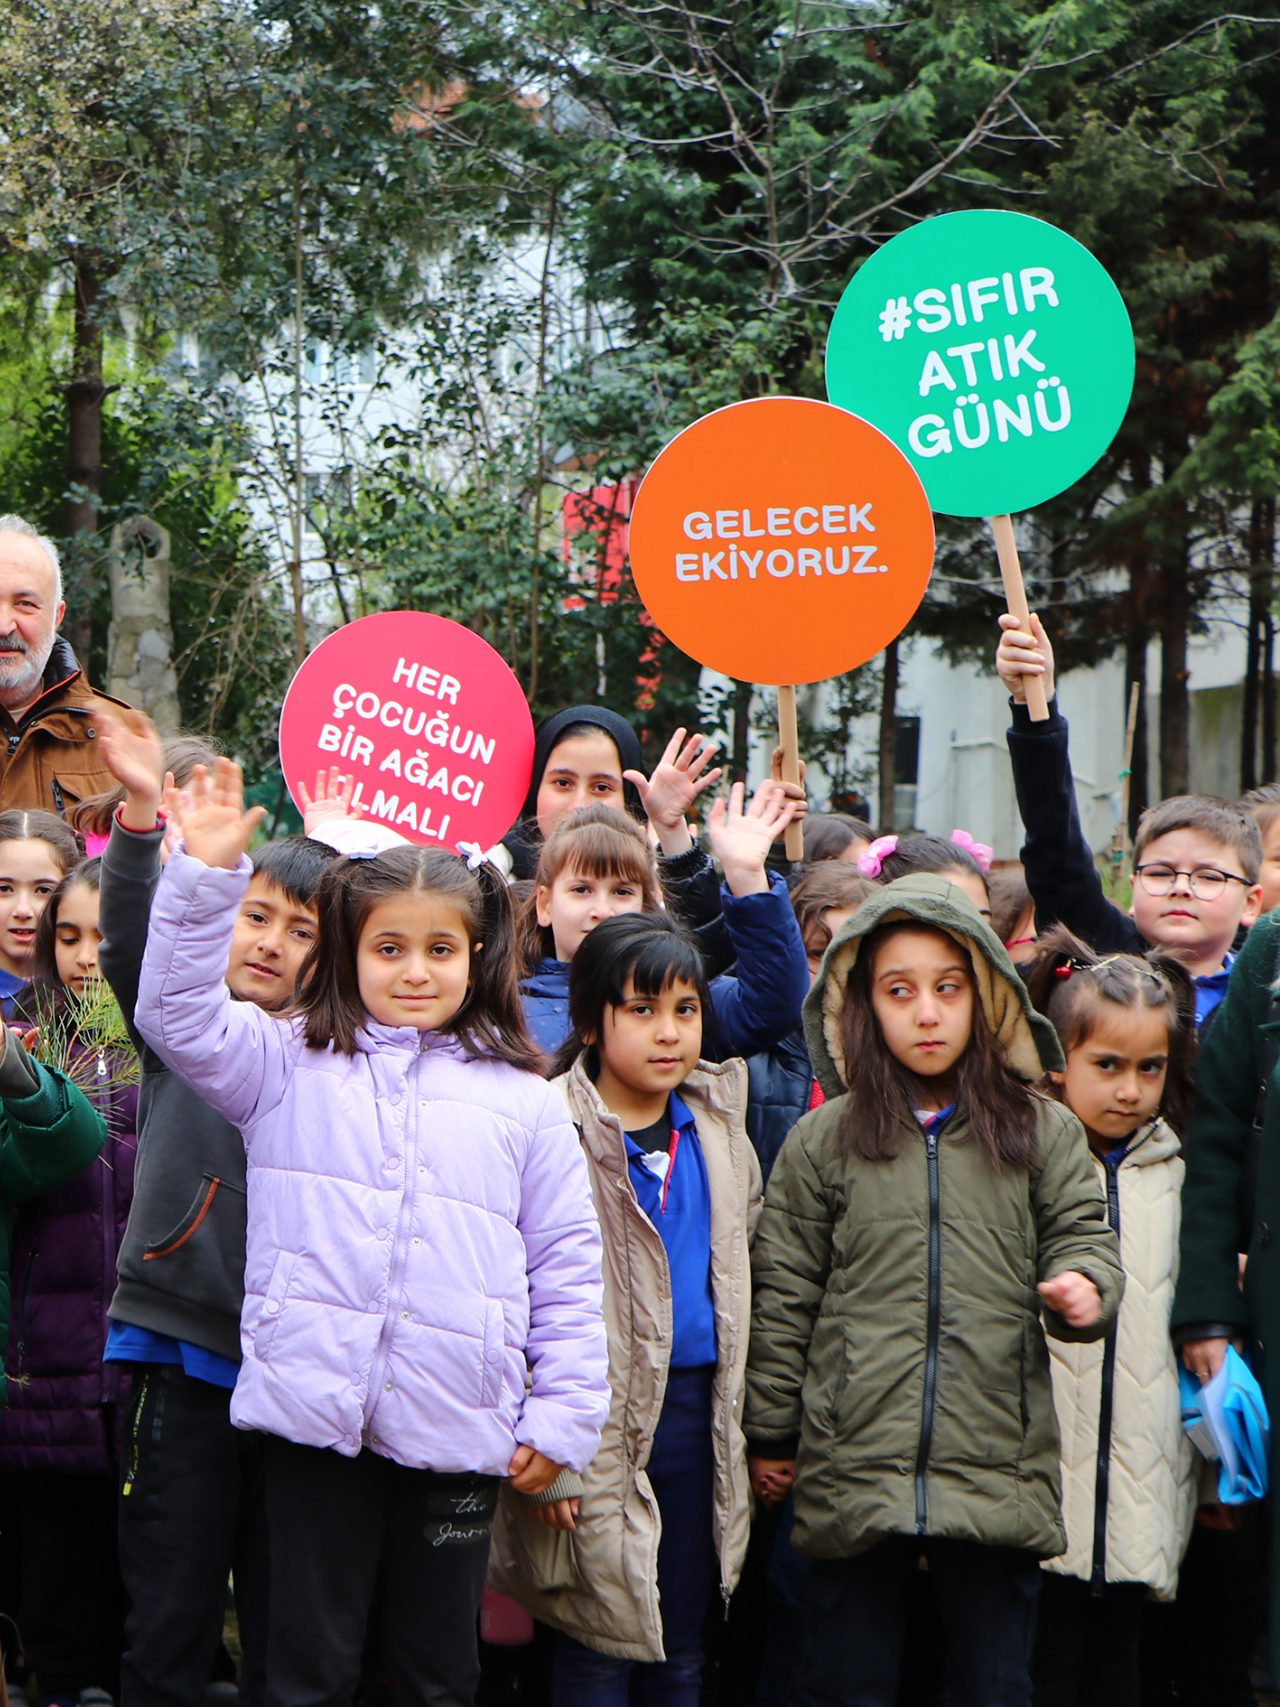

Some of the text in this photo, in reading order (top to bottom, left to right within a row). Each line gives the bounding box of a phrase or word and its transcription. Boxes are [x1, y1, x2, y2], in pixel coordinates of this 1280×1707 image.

[878, 266, 1060, 342] #SIFIR
[918, 329, 1046, 397] ATIK
[907, 376, 1072, 459] GÜNÜ
[682, 502, 876, 541] GELECEK
[674, 543, 889, 582] EKİYORUZ.
[392, 657, 462, 706] HER
[332, 683, 497, 765] ÇOCUĞUN
[317, 723, 485, 807] BİR AĞACI
[336, 775, 451, 840] LMALI
